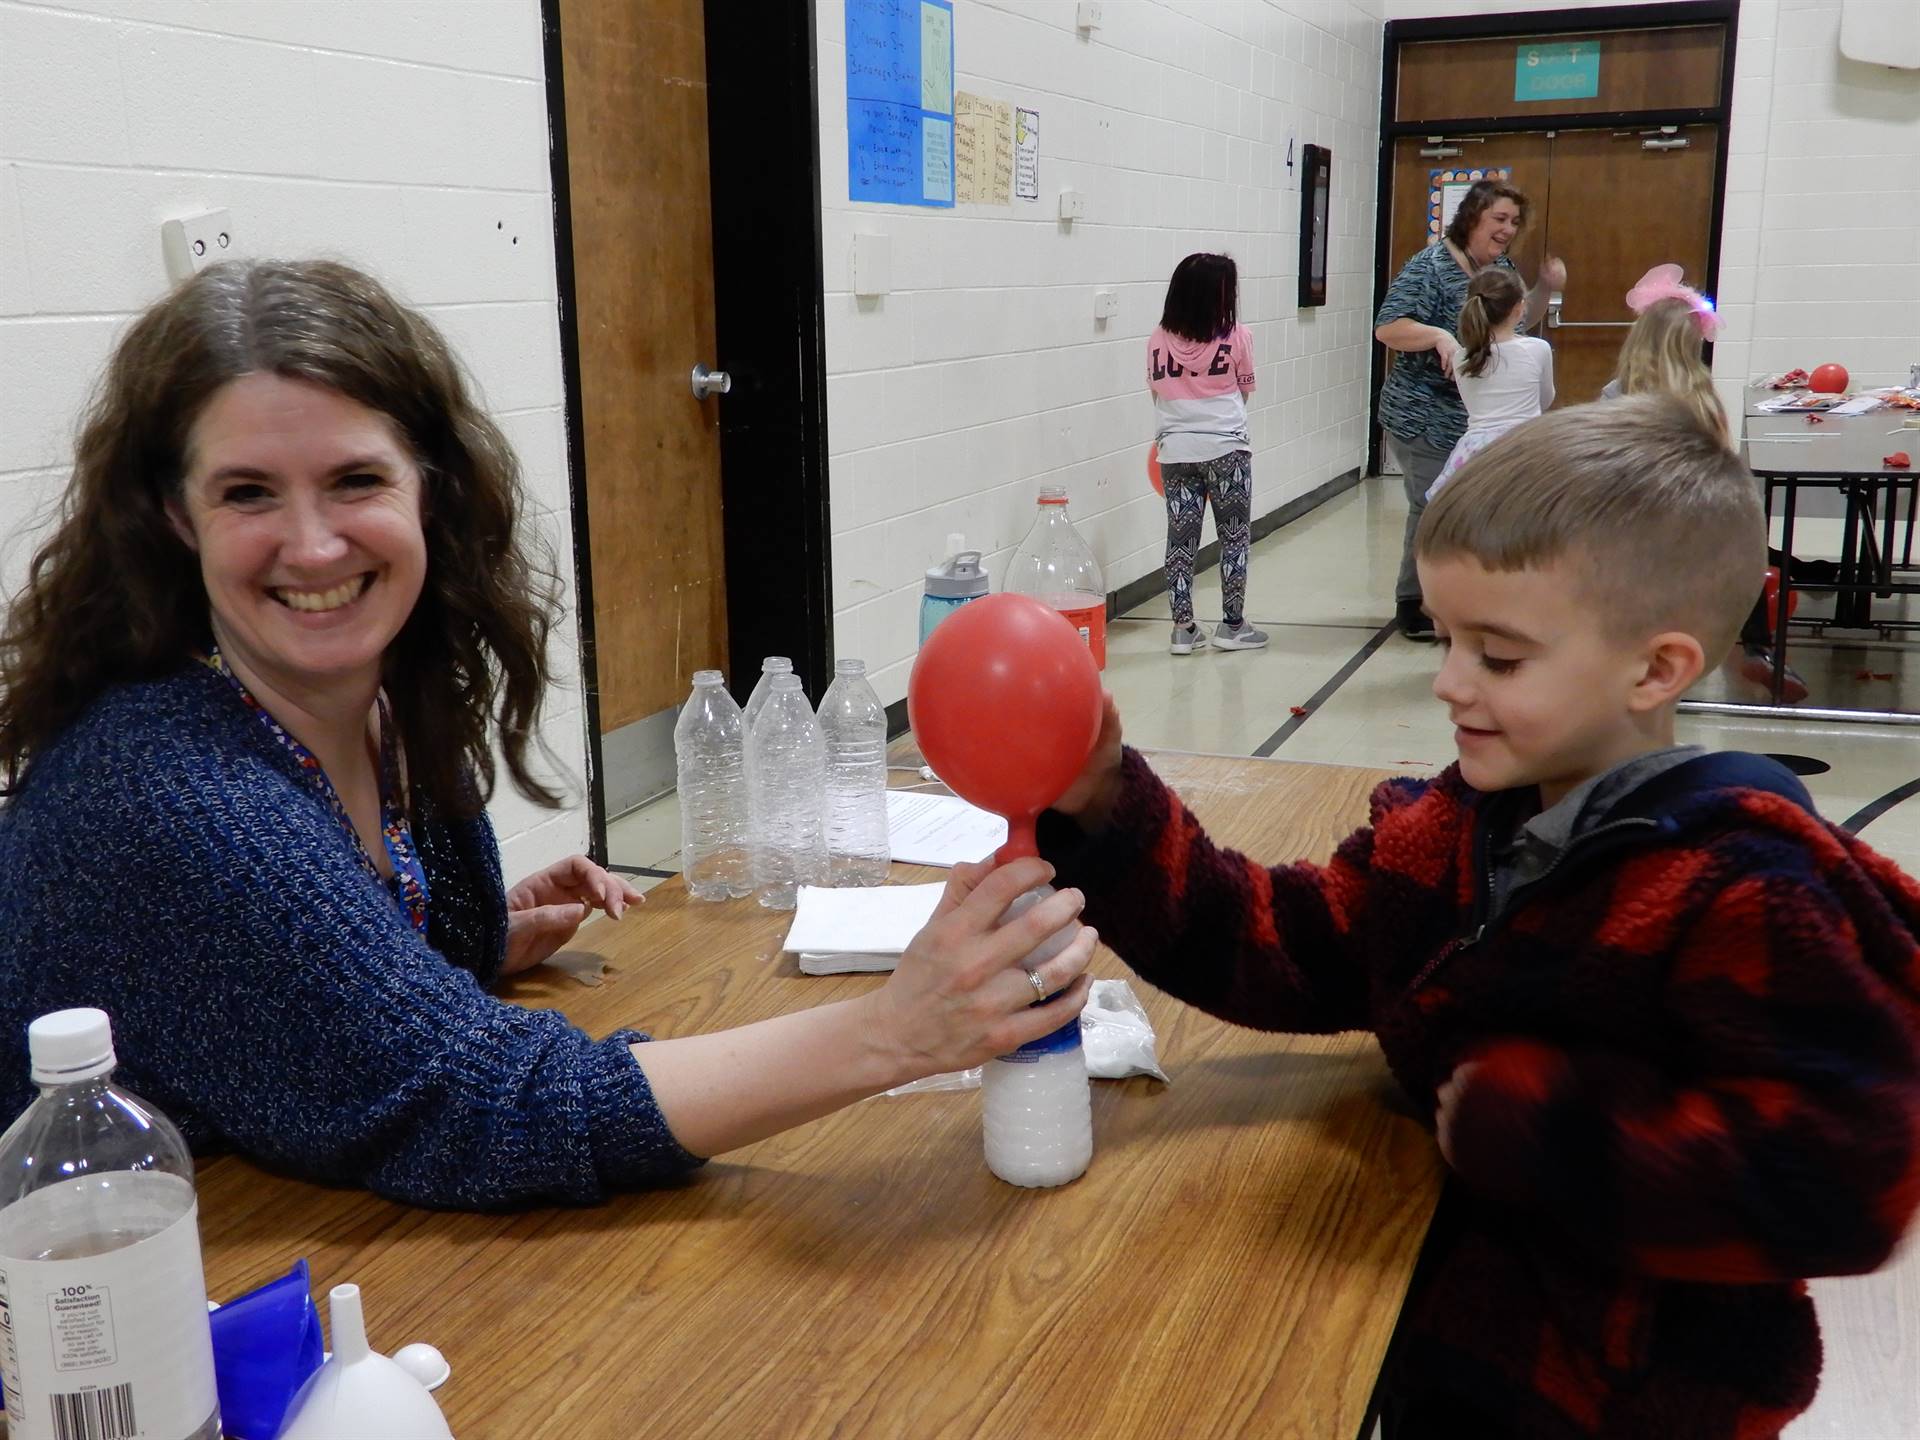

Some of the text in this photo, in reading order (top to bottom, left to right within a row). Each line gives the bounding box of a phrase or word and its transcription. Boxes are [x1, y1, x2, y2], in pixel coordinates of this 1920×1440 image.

[1286, 138, 1294, 176] 4
[1152, 344, 1232, 380] LOE
[61, 1284, 92, 1297] 100%
[54, 1300, 102, 1311] Guaranteed!
[55, 1294, 101, 1304] Satisfaction
